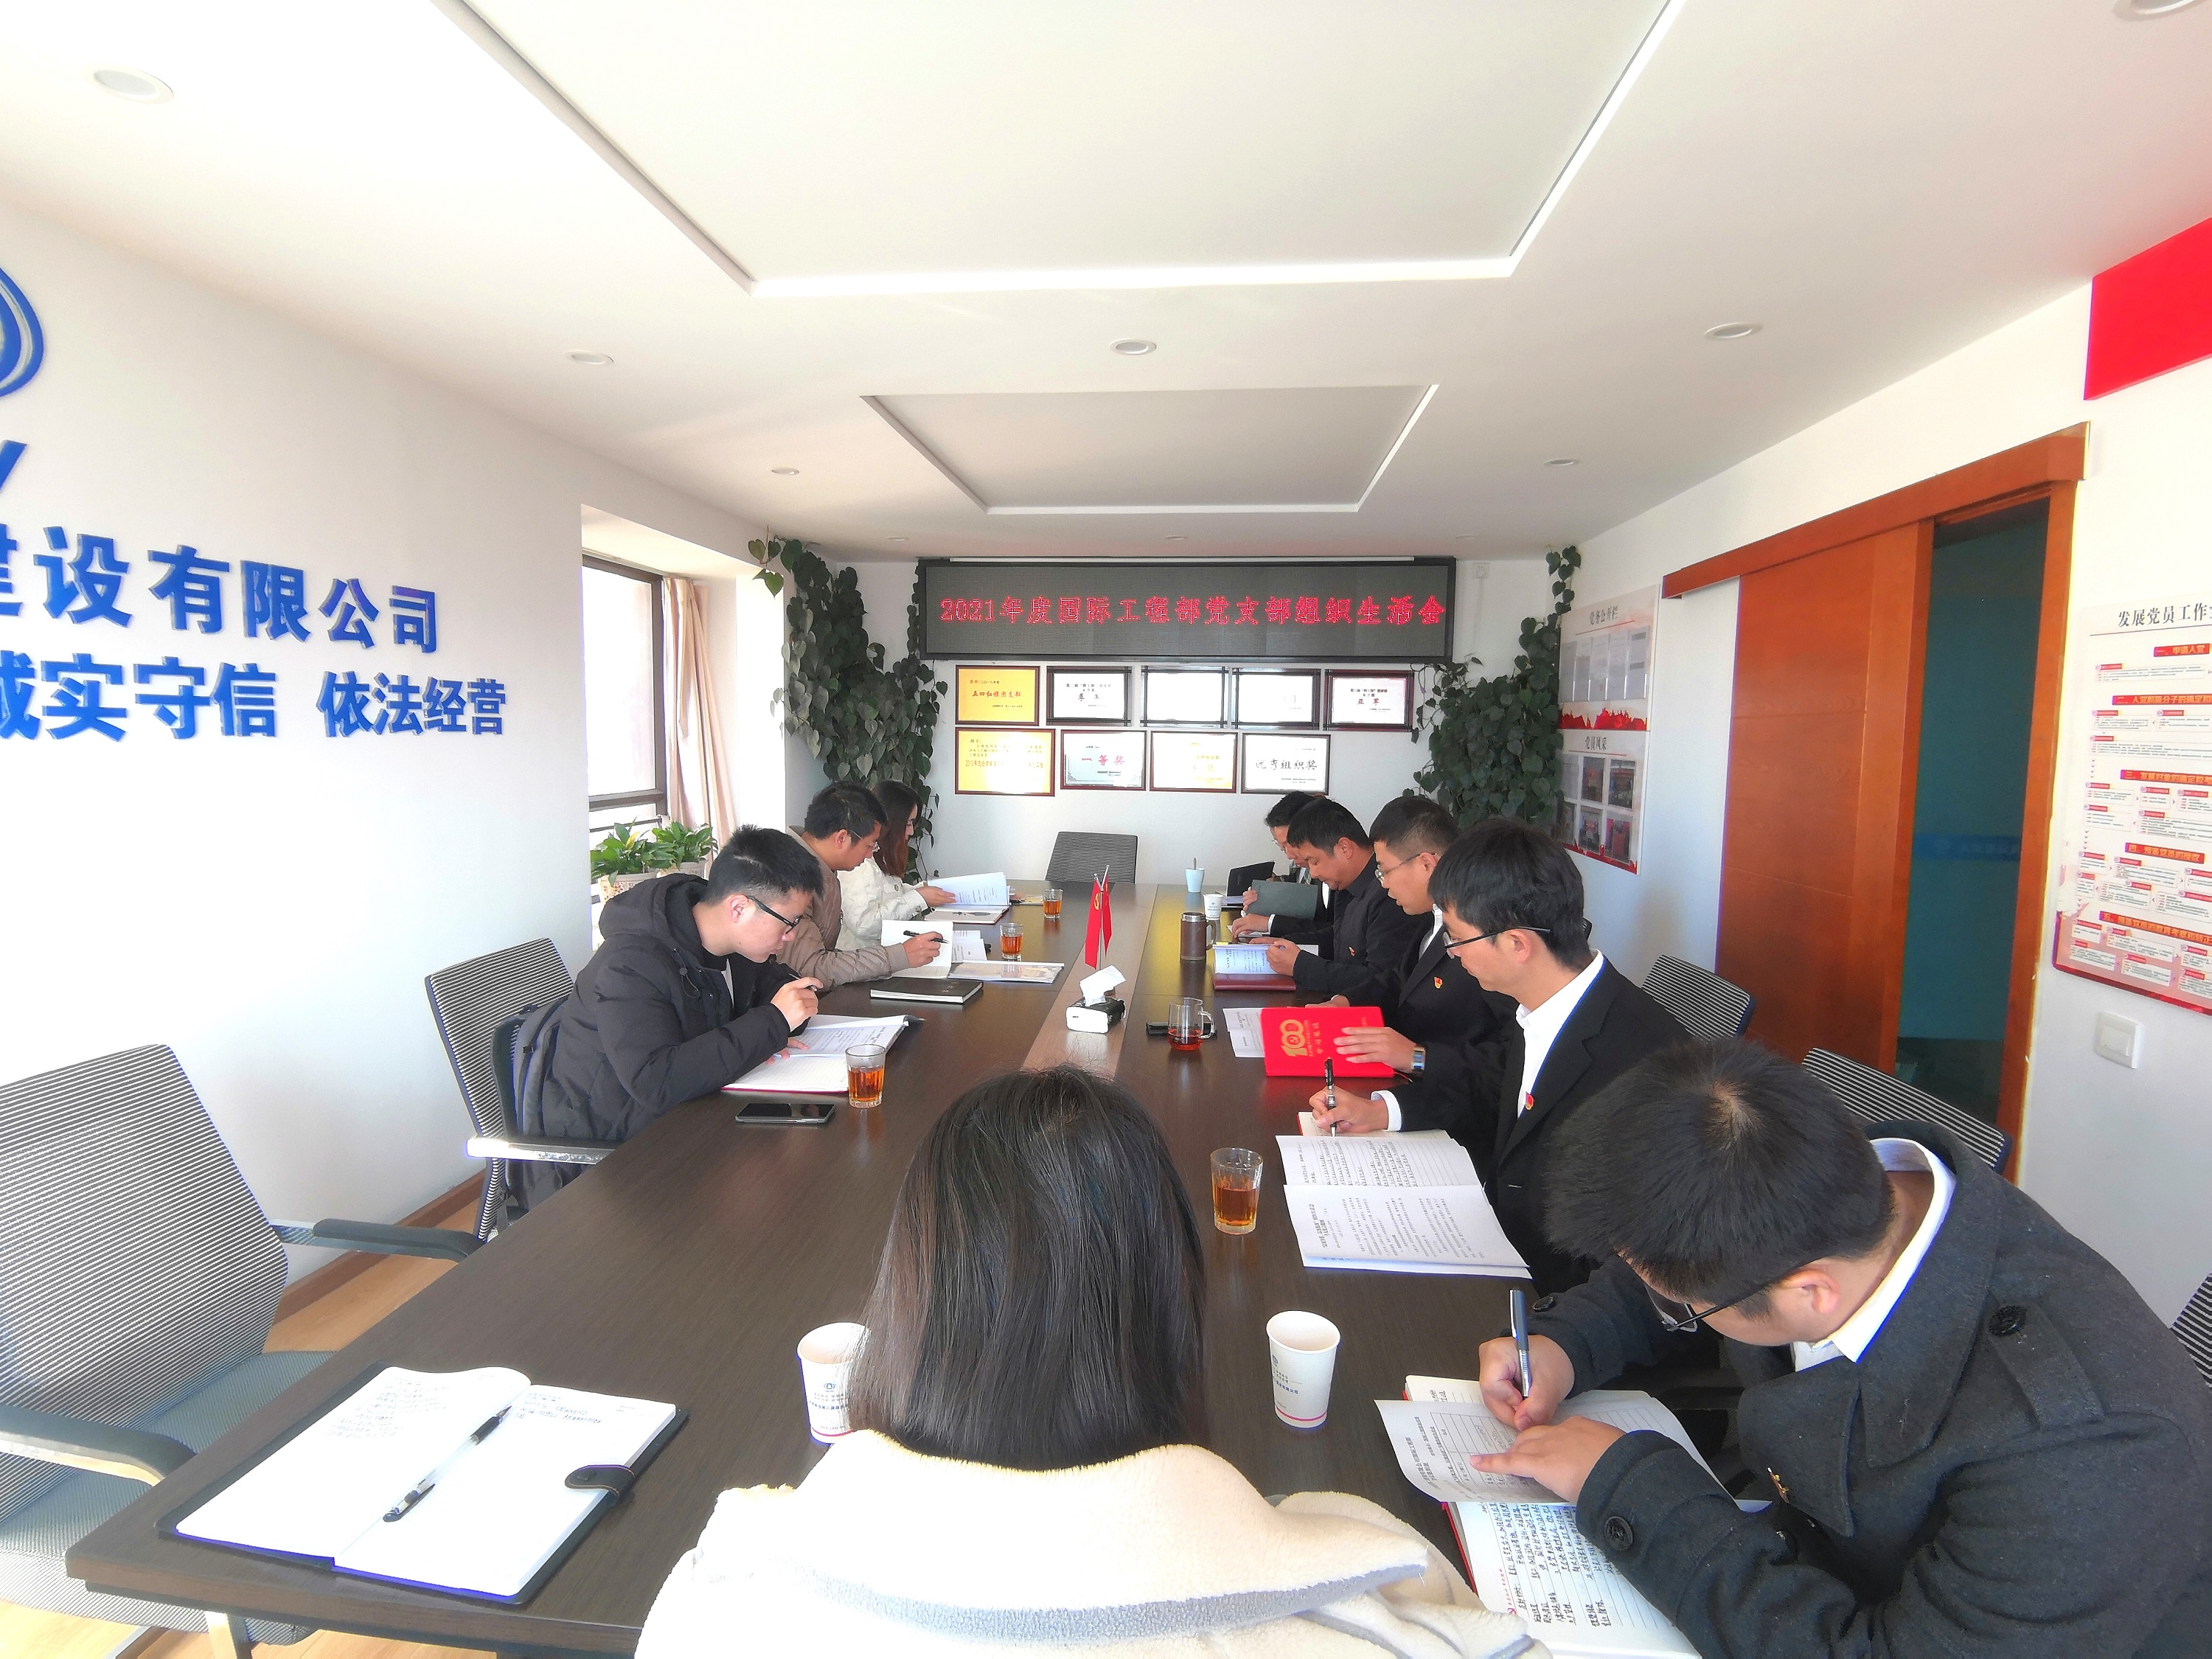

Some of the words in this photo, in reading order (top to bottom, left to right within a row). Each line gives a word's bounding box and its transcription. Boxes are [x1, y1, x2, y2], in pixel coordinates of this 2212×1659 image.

[0, 524, 438, 653] 设有限公司
[939, 595, 1446, 625] 2021年度国际工程部党支部组织生活会
[2118, 602, 2212, 627] 发展党员工作
[317, 672, 507, 738] 依法经营
[1256, 758, 1318, 771] 优秀组织奖
